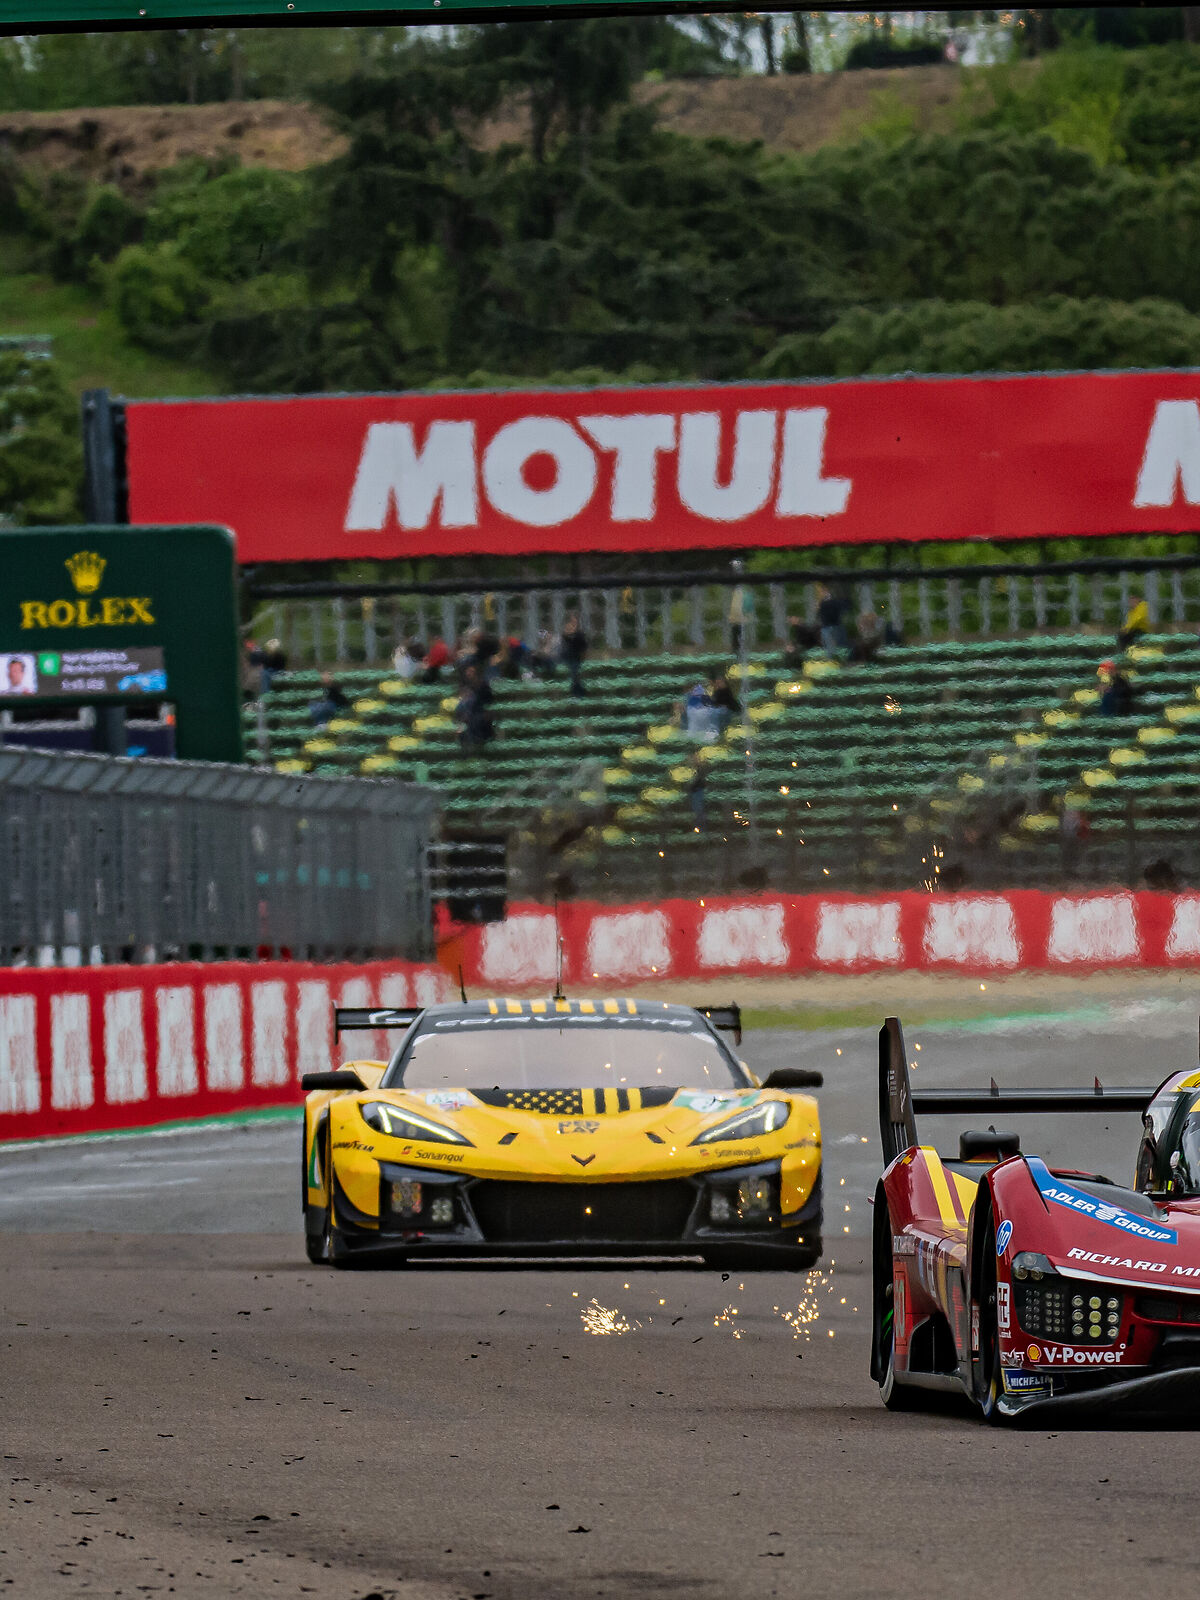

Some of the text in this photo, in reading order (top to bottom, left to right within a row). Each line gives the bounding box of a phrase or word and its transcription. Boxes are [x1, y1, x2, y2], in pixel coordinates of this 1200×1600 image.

[344, 406, 852, 532] MOTUL
[20, 598, 155, 629] ROLEX
[414, 1149, 465, 1163] Sonangol
[1040, 1188, 1172, 1241] ADLER GROUP
[1067, 1247, 1168, 1273] RICHARD
[1043, 1346, 1124, 1363] V-Power
